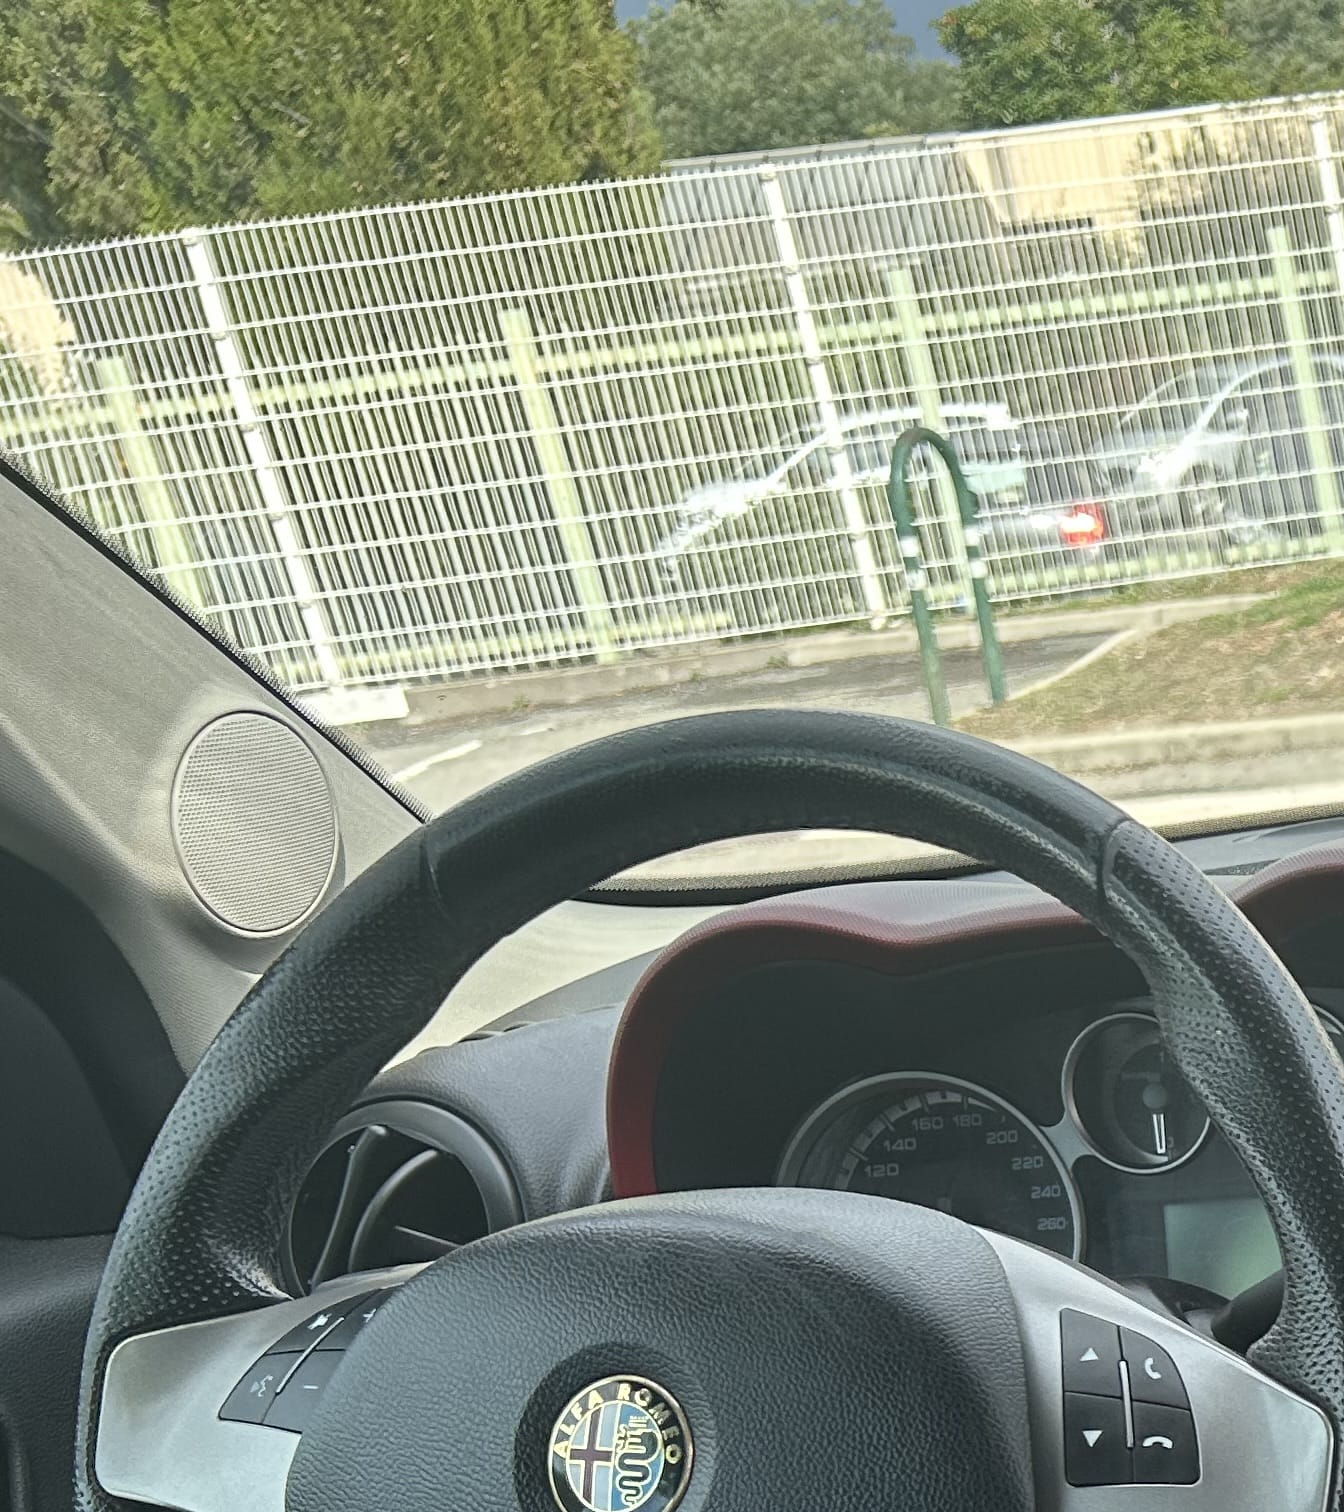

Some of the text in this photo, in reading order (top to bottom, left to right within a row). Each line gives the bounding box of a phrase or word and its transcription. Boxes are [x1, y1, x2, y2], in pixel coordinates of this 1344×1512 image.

[911, 1115, 944, 1131] 160
[883, 1136, 918, 1152] 140
[986, 1129, 1018, 1145] 200
[863, 1162, 901, 1178] 120
[1011, 1155, 1045, 1171] 220
[1030, 1184, 1062, 1200] 240
[1037, 1217, 1067, 1231] 260
[552, 1382, 683, 1465] ALFA ROMEO
